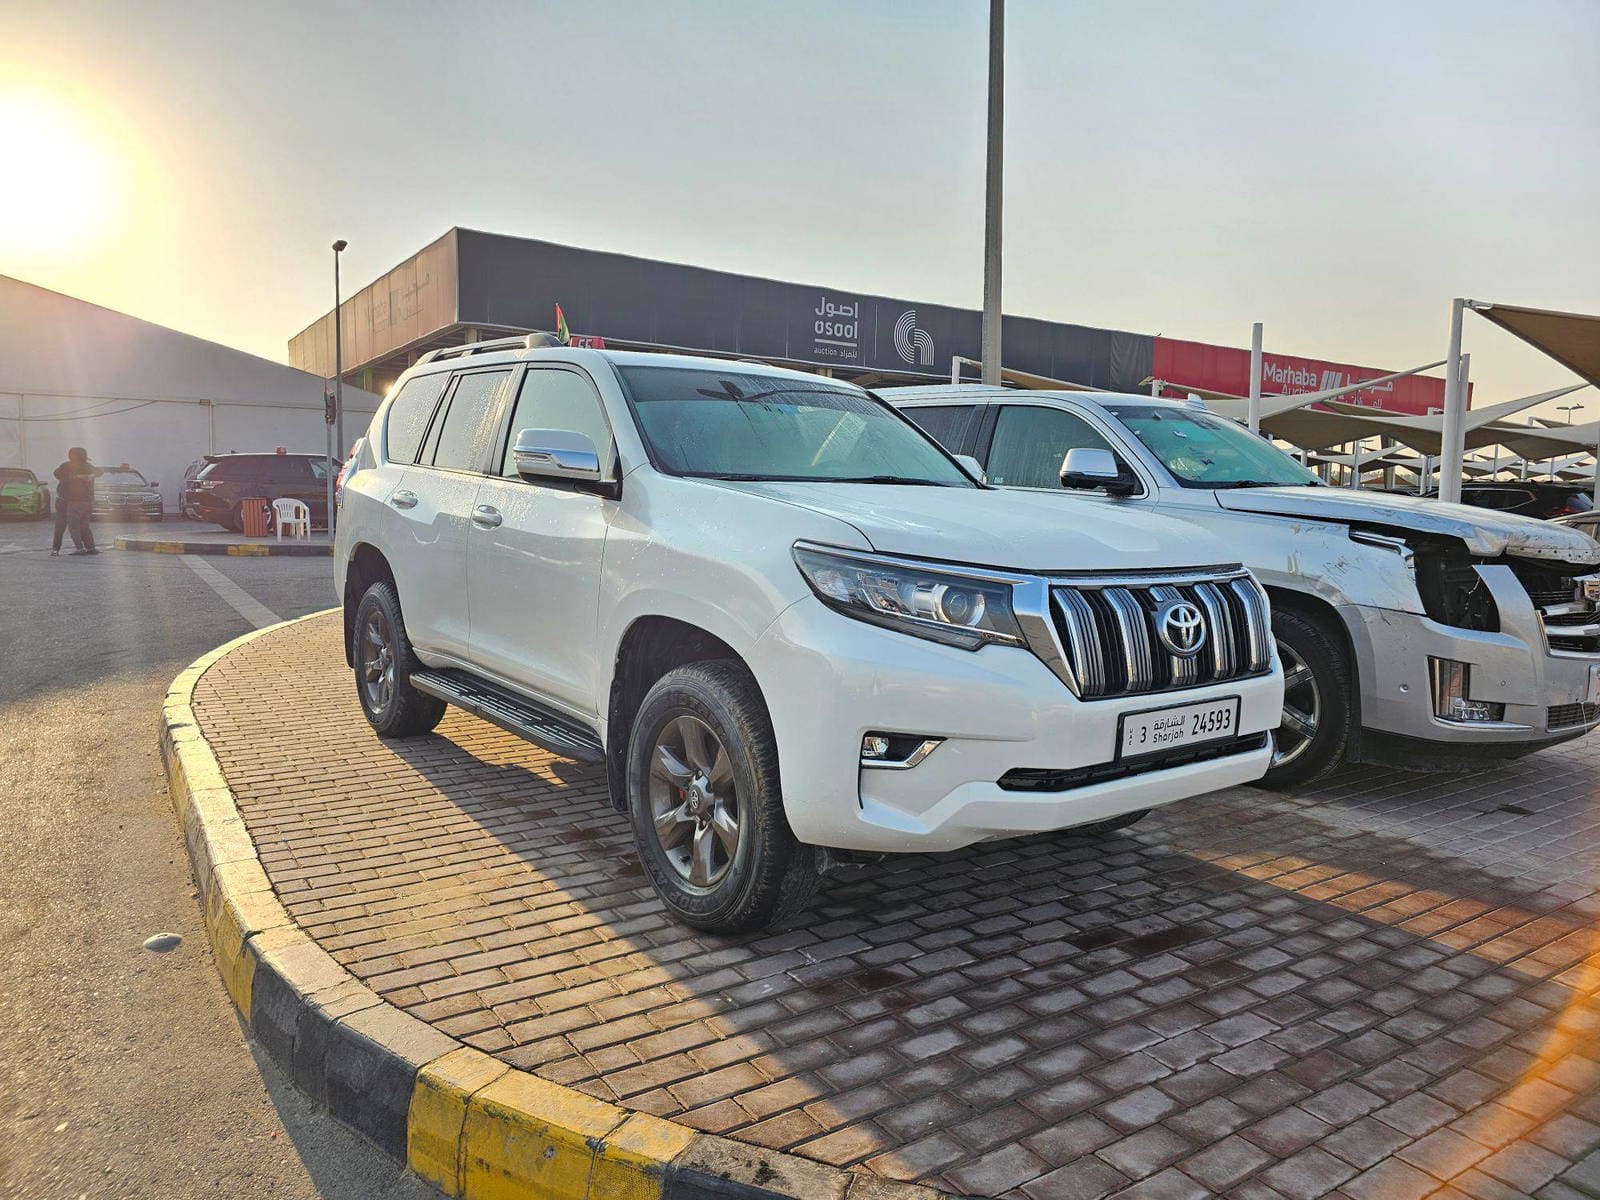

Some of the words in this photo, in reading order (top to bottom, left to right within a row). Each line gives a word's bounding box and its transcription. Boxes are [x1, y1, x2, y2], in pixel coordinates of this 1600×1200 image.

[813, 347, 837, 356] auction
[1263, 361, 1317, 387] Marhaba
[1153, 715, 1186, 731] الشارقة
[1191, 708, 1231, 736] 24593
[1140, 726, 1147, 743] 3
[1152, 728, 1184, 743] Sharjah
